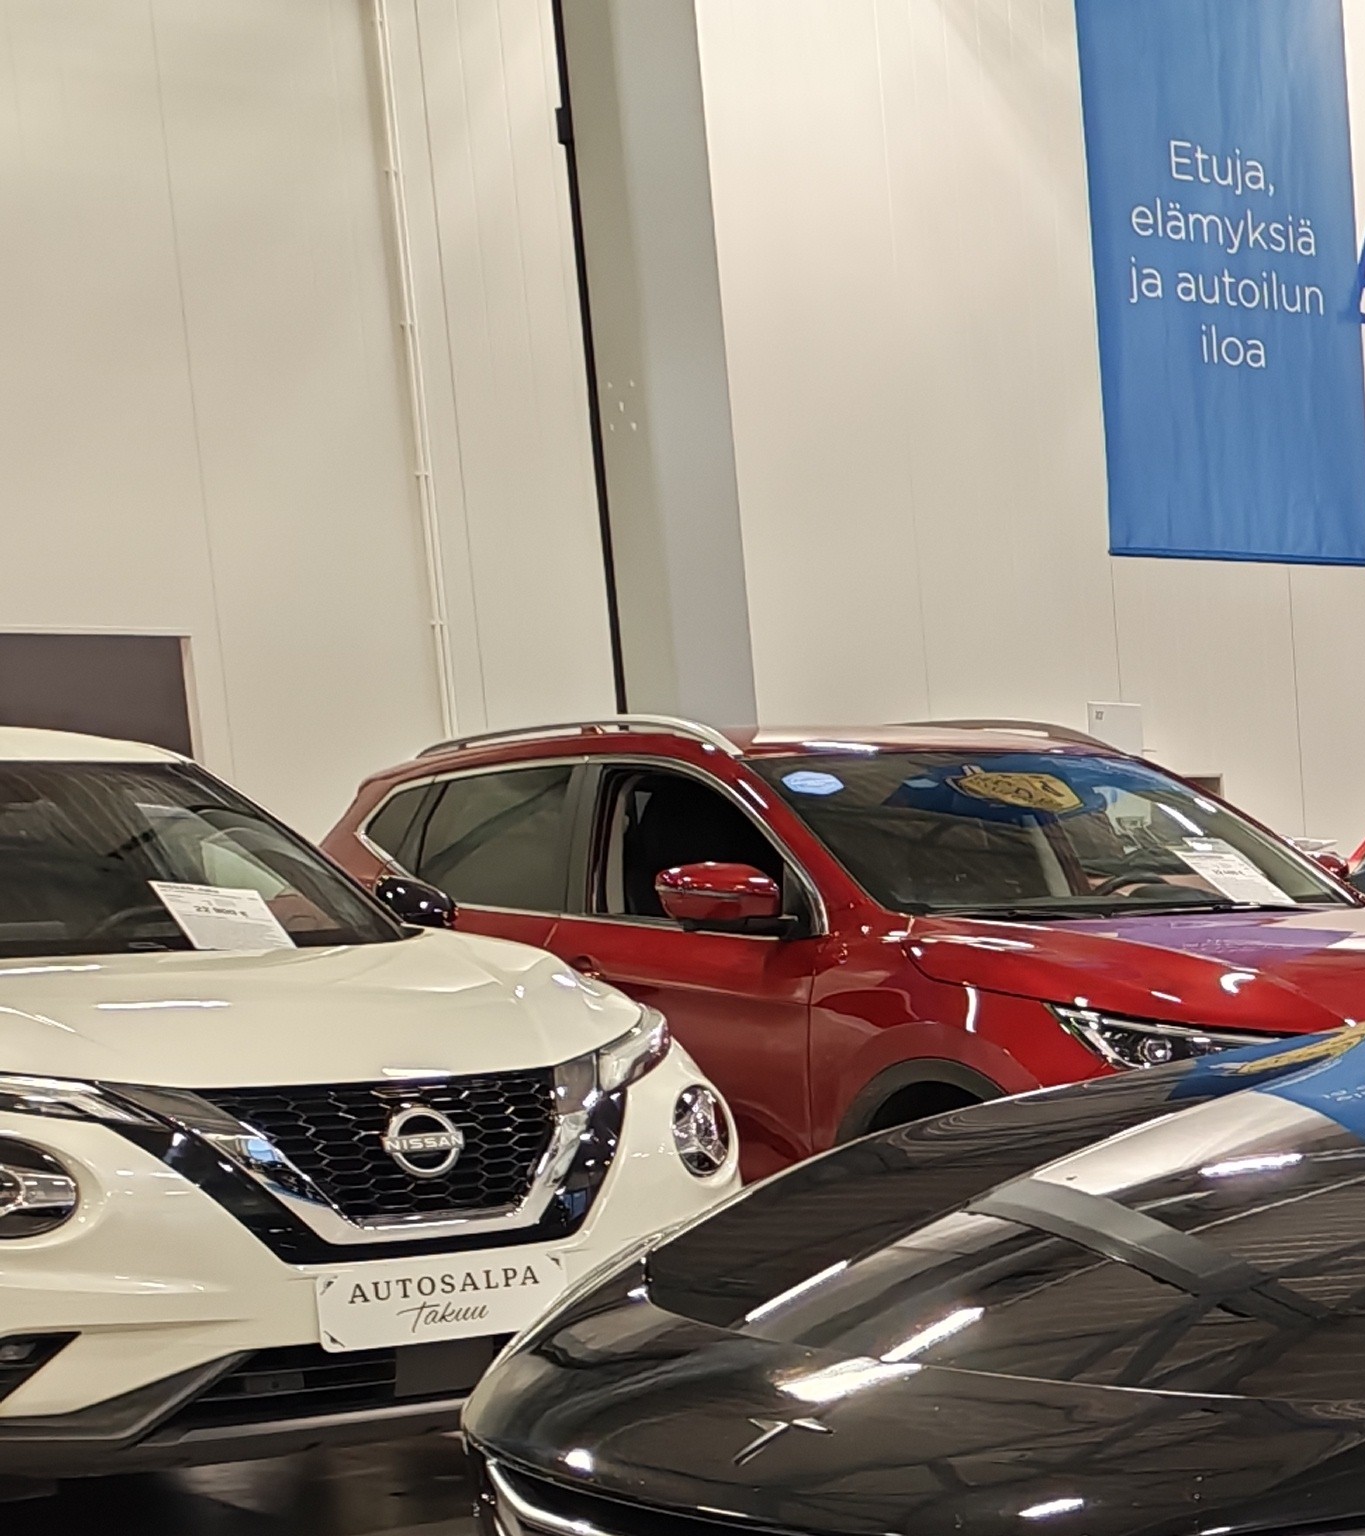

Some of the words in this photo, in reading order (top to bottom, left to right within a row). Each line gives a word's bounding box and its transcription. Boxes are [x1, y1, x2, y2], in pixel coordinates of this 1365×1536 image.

[1169, 139, 1275, 198] Etuja,
[1131, 196, 1317, 257] elämyksiä
[1129, 256, 1163, 304] ja
[1176, 268, 1325, 316] autoilun
[1201, 323, 1266, 369] iloa
[385, 1135, 463, 1151] NISSAN
[348, 1265, 540, 1304] AUTOSALPA
[396, 1301, 489, 1334] Takuu
